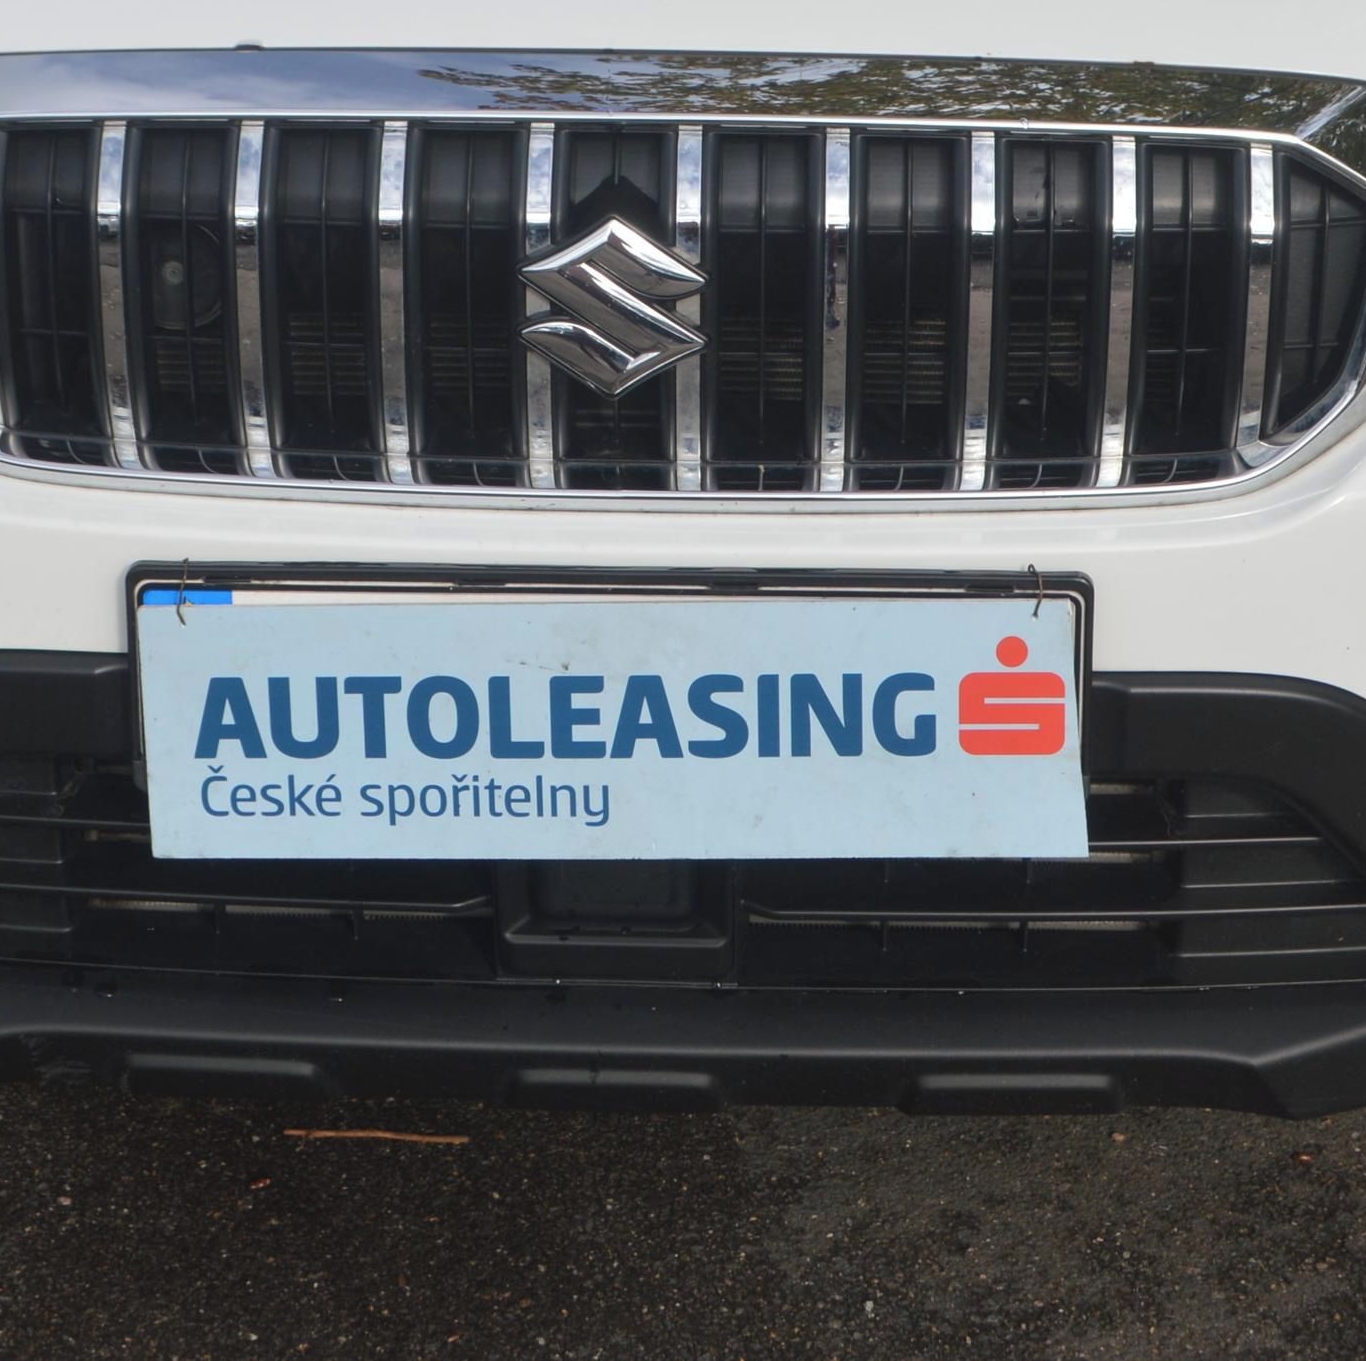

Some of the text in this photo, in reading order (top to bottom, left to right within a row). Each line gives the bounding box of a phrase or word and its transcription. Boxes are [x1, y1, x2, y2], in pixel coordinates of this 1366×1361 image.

[193, 671, 937, 761] AUTOLEASING
[200, 763, 611, 828] České spořitelny
